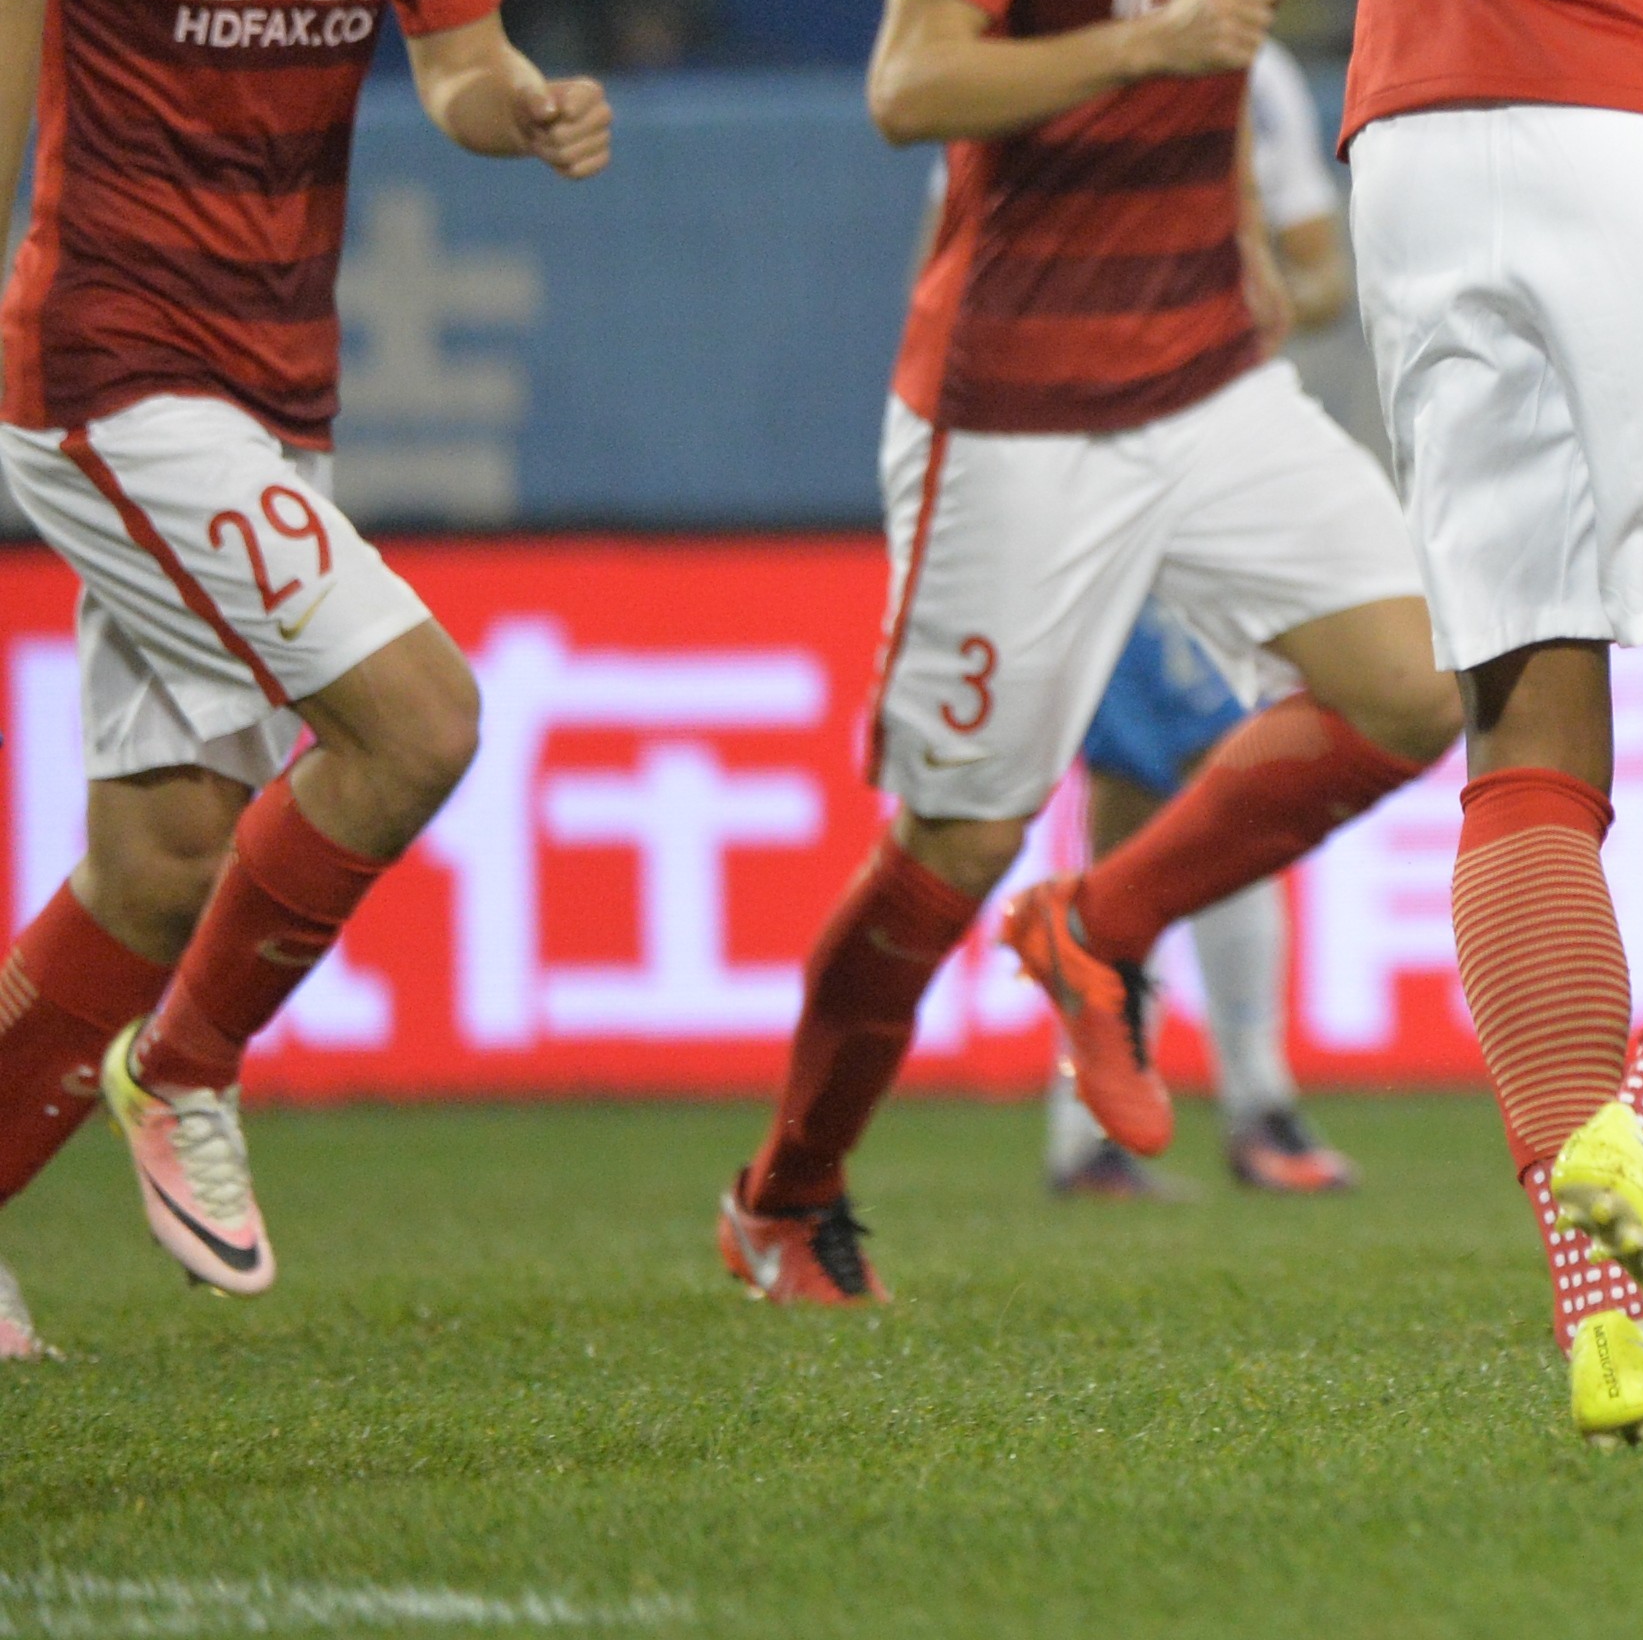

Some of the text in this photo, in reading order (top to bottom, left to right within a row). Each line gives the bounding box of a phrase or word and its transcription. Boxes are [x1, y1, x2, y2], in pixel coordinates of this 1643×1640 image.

[174, 5, 374, 48] HDFAX.CO
[208, 484, 331, 612] 29
[941, 637, 997, 734] 3
